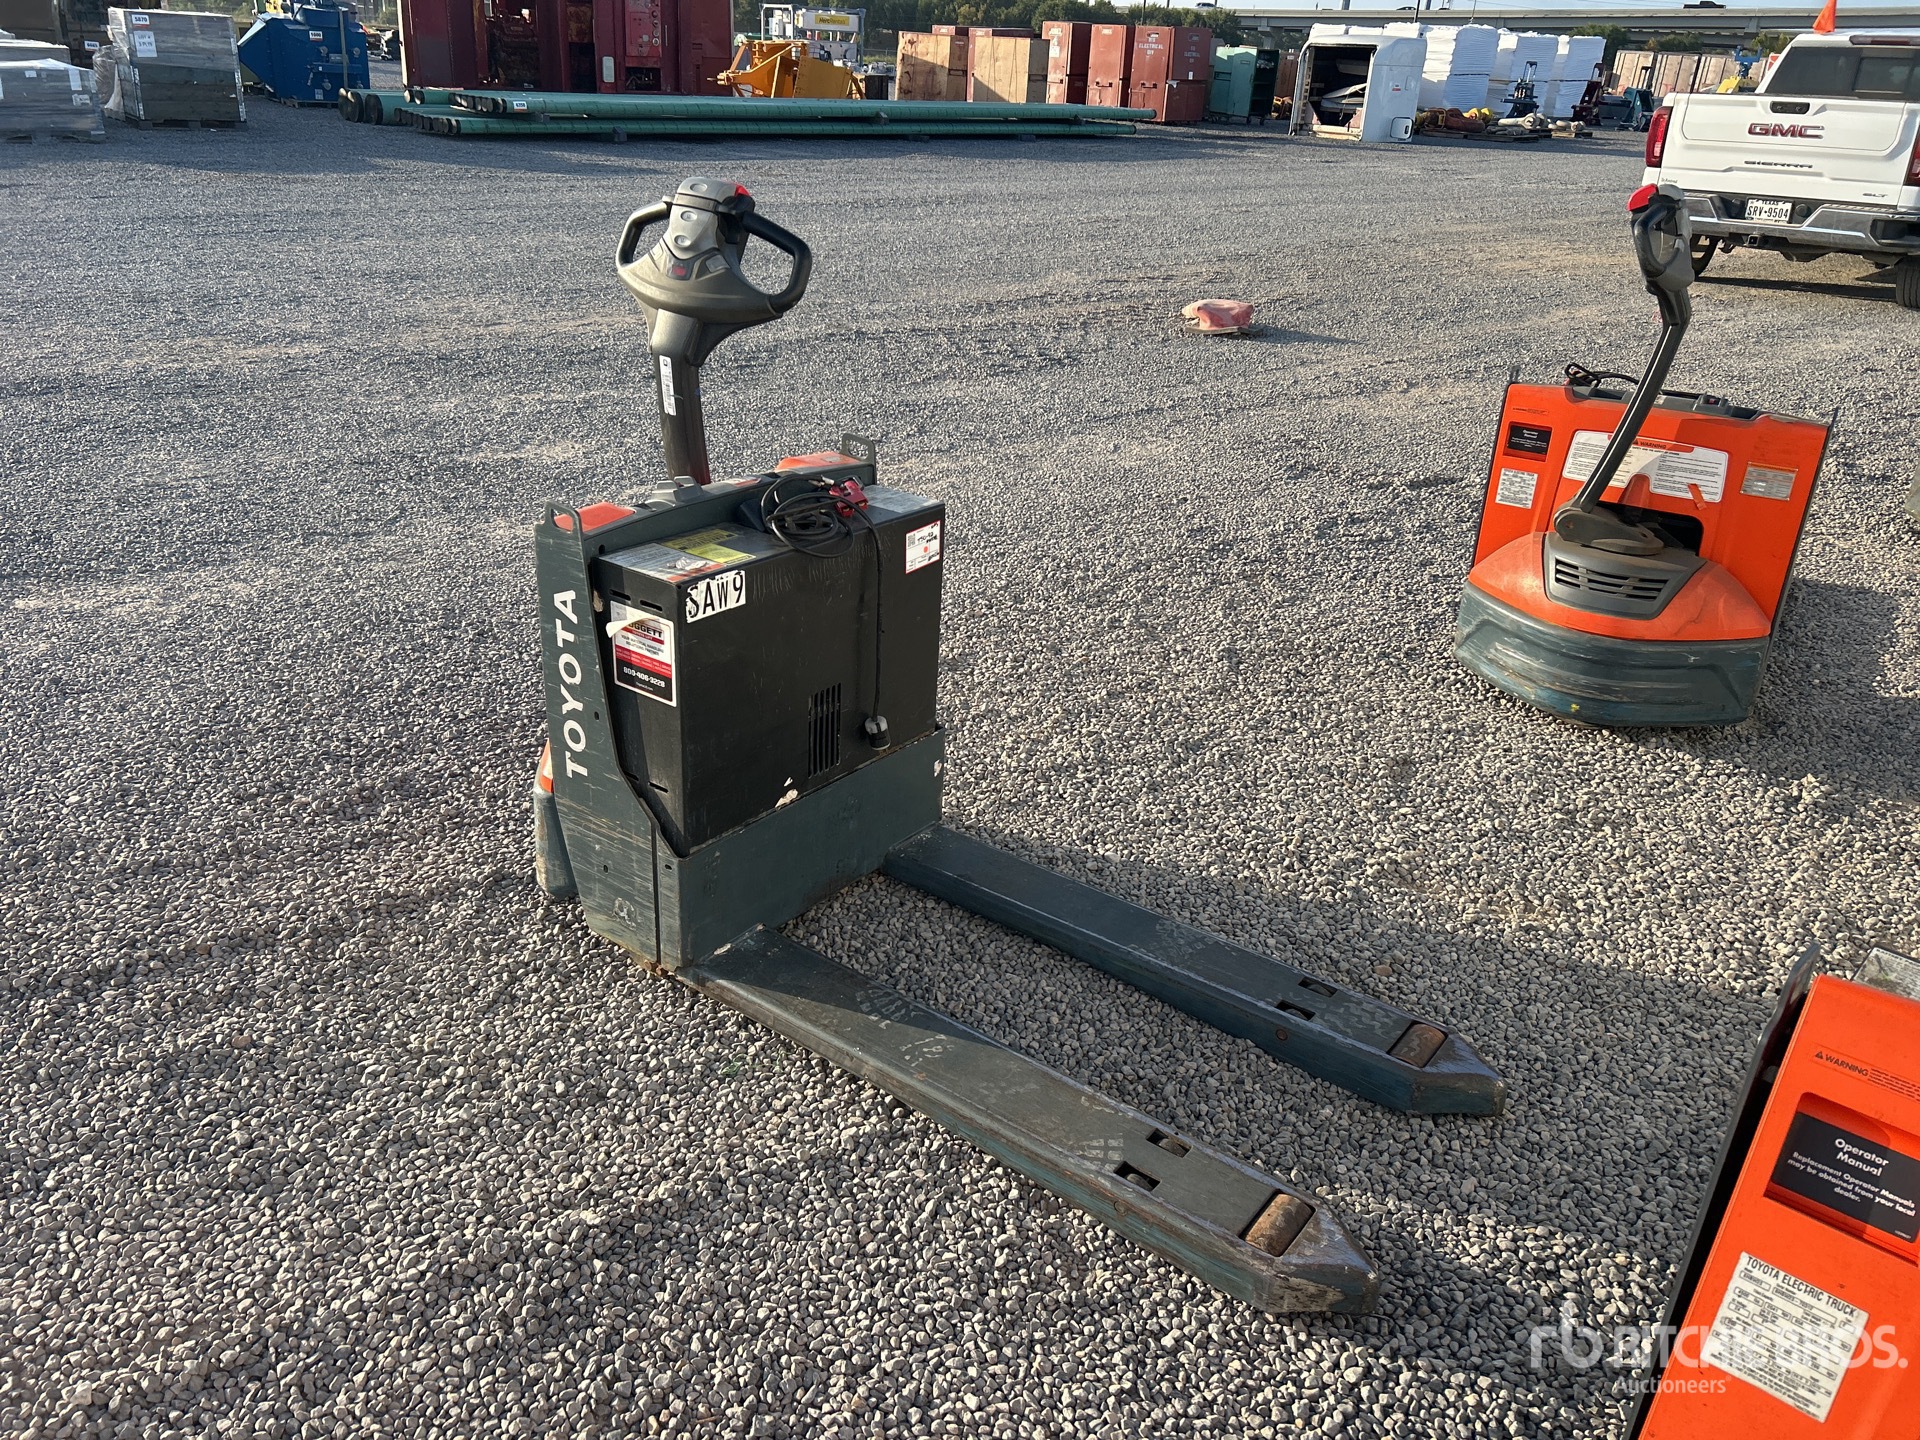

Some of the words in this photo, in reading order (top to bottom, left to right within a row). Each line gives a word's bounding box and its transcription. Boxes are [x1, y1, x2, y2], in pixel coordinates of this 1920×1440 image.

[1748, 122, 1824, 139] GMC
[1744, 160, 1813, 169] SIERRA
[1640, 441, 1666, 449] WARNING
[686, 570, 744, 618] SAW9
[553, 589, 588, 779] TOYOTA
[1825, 1053, 1869, 1077] WARNING
[1835, 1138, 1889, 1166] Operator
[1836, 1152, 1883, 1177] Manual
[1788, 1159, 1806, 1171] may
[1806, 1165, 1818, 1175] be
[1818, 1171, 1854, 1190] obtained
[1854, 1185, 1874, 1199] from
[1874, 1196, 1894, 1208] your
[1895, 1203, 1916, 1217] local
[1792, 1151, 1842, 1177] Replacement
[1843, 1173, 1880, 1193] Operator
[1880, 1188, 1915, 1209] Manuals
[1833, 1186, 1861, 1202] dealer.
[1747, 1256, 1779, 1280] TOYOTA
[1781, 1275, 1824, 1302] ELECTRIC
[1825, 1296, 1858, 1318] TRUCK
